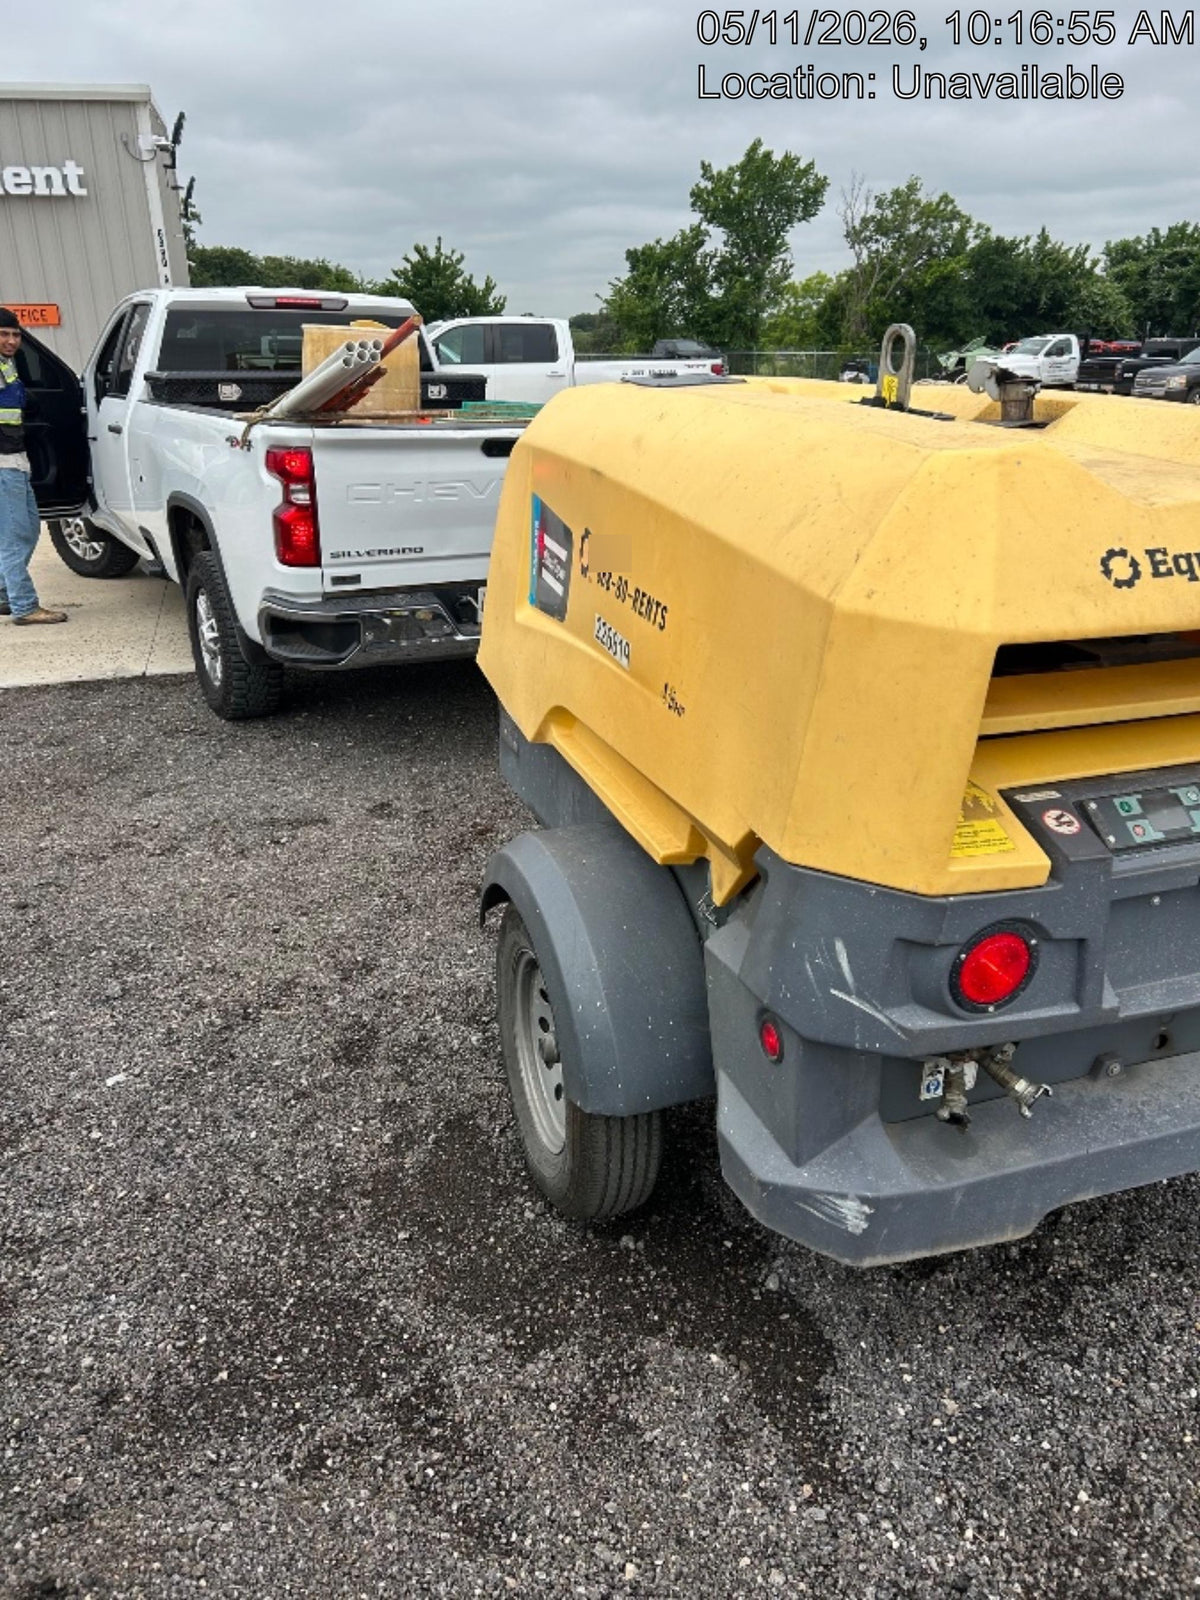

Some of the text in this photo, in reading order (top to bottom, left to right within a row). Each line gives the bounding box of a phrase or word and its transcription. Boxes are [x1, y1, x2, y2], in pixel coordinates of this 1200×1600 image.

[0, 159, 88, 196] ent
[13, 308, 48, 323] FICE
[346, 478, 505, 505] CHEV
[329, 546, 424, 559] SILVERADO
